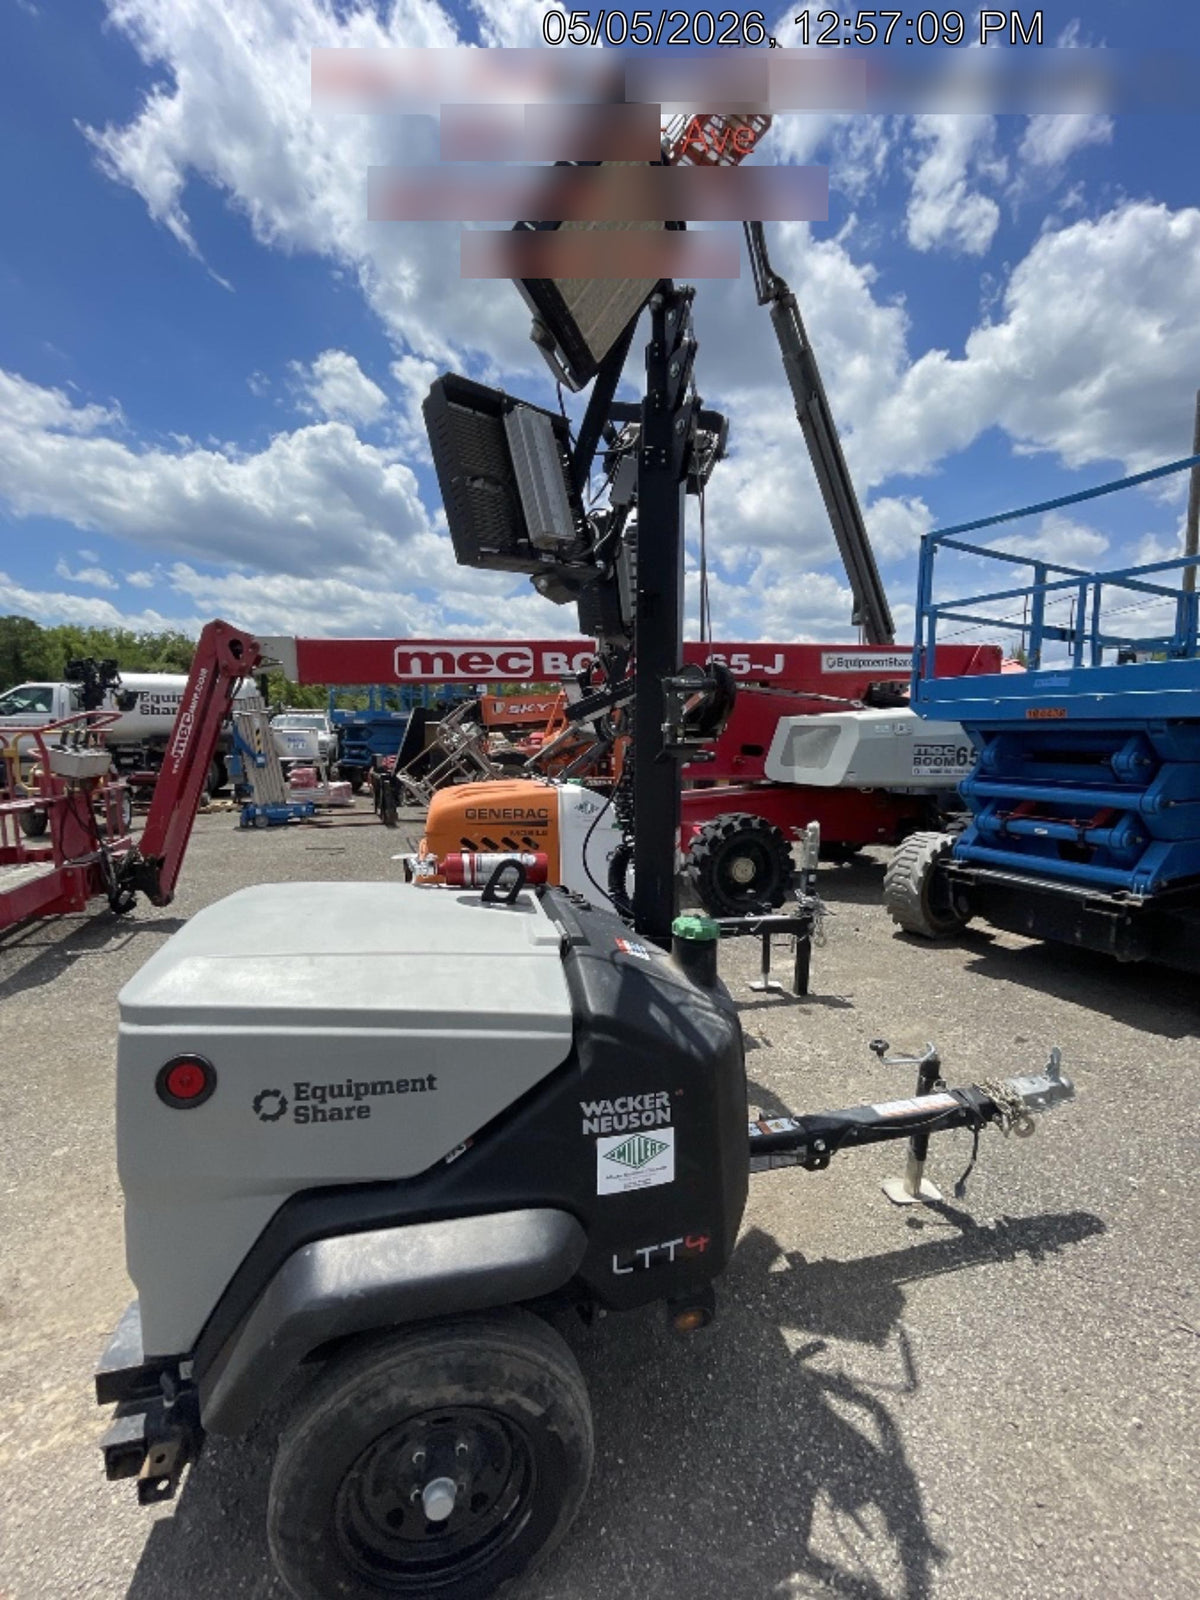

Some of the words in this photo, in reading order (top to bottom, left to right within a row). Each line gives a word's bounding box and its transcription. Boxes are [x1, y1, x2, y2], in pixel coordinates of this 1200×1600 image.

[397, 651, 532, 675] mec
[542, 651, 600, 675] BO
[140, 691, 185, 705] Equip
[140, 704, 178, 715] Shar
[913, 757, 955, 767] BOOM
[465, 808, 549, 820] GENERAC
[294, 1074, 437, 1104] Equipment
[294, 1104, 371, 1125] Share
[579, 1091, 671, 1117] WACKER
[582, 1107, 671, 1135] NEUSON
